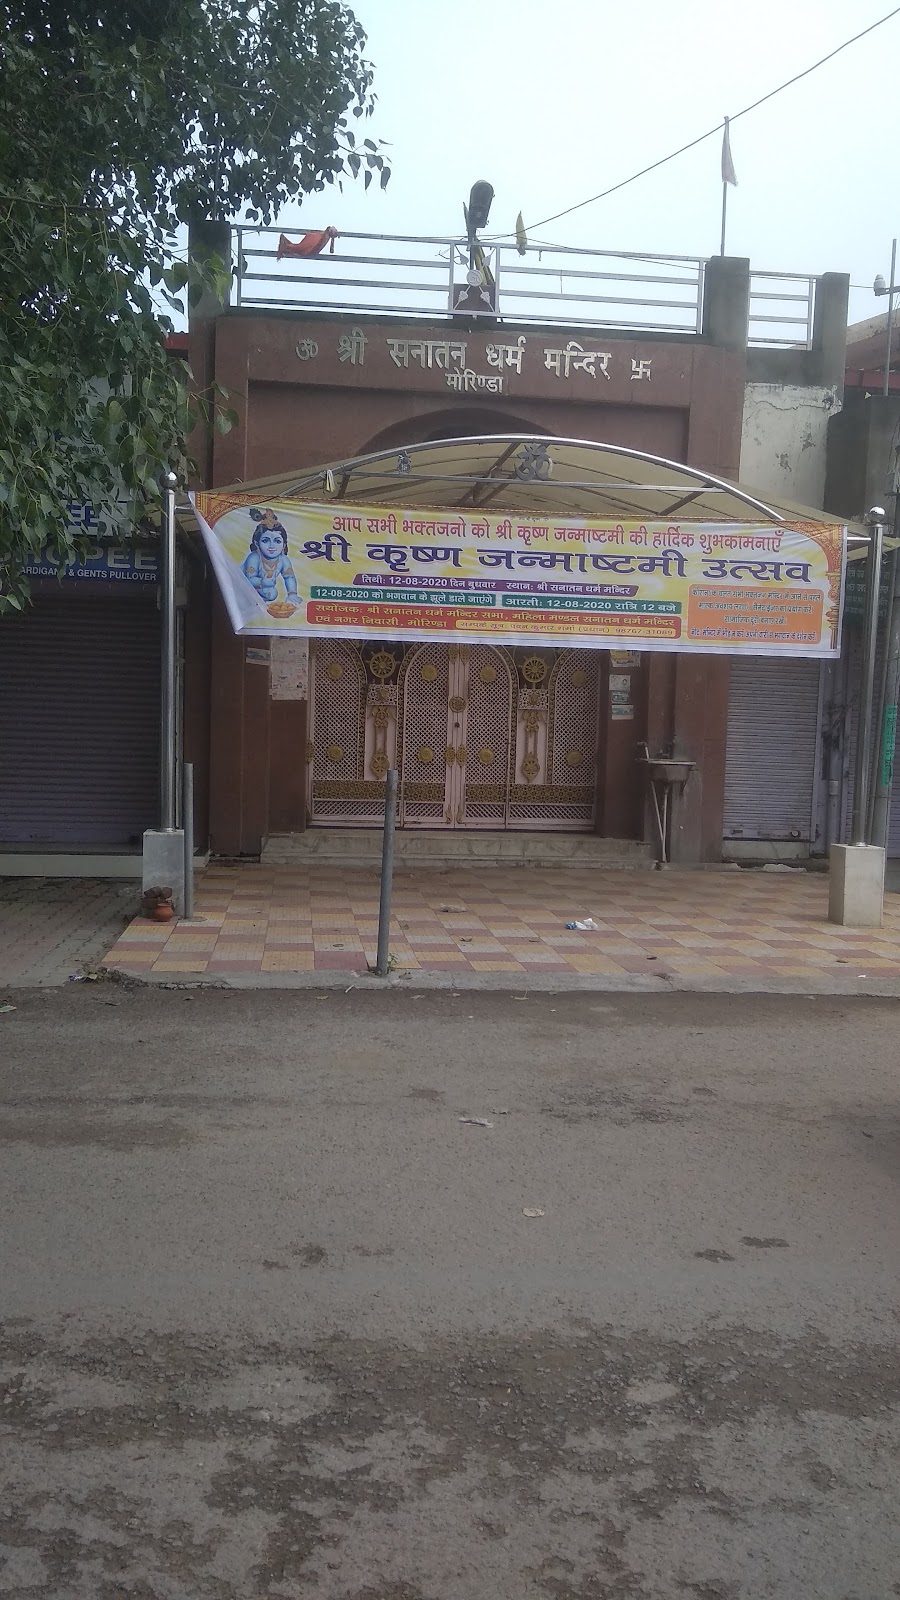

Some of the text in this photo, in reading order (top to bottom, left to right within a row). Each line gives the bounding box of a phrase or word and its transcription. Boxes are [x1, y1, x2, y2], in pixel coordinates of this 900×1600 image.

[336, 328, 368, 366] श्री
[386, 337, 467, 370] सनातन
[485, 335, 526, 374] धर्म
[543, 341, 612, 380] मन्दिर
[445, 368, 504, 393] मोरिण्डा
[332, 514, 785, 554] आप सभी भक्तजनो को श्री कृष्ण जन्माष्टमी की हार्दिक शुभकामनाएँ
[300, 533, 813, 583] श्री कृष्ण जन्माष्टमी उत्सव
[68, 568, 75, 577] &
[77, 569, 107, 579] GENTS
[109, 570, 157, 581] PULLOVER
[362, 574, 386, 584] तिथी:
[389, 576, 448, 587] 12-08-2020
[450, 579, 465, 588] दिन
[468, 581, 496, 590] बुधवार
[506, 582, 533, 591] स्थान:
[536, 582, 548, 591] श्री
[585, 584, 601, 593] धर्म
[603, 585, 631, 595] मन्दिर
[316, 588, 492, 604] 12-08-2020 को भगवान के झूले डाले जाएंगे
[505, 598, 676, 612] आरती: 12-08-2020 रात्रि 12 बजे
[315, 614, 330, 623] एवं
[334, 616, 358, 624] नगर
[407, 618, 447, 627] मोरिण्डा
[367, 605, 379, 614] श्री
[383, 607, 421, 615] सनातन
[425, 607, 443, 616] धर्म
[447, 609, 478, 618] मन्दिर
[512, 612, 545, 620] महिला
[548, 614, 580, 622] मण्डल
[623, 616, 641, 624] धर्म
[643, 617, 675, 626] मन्दिर
